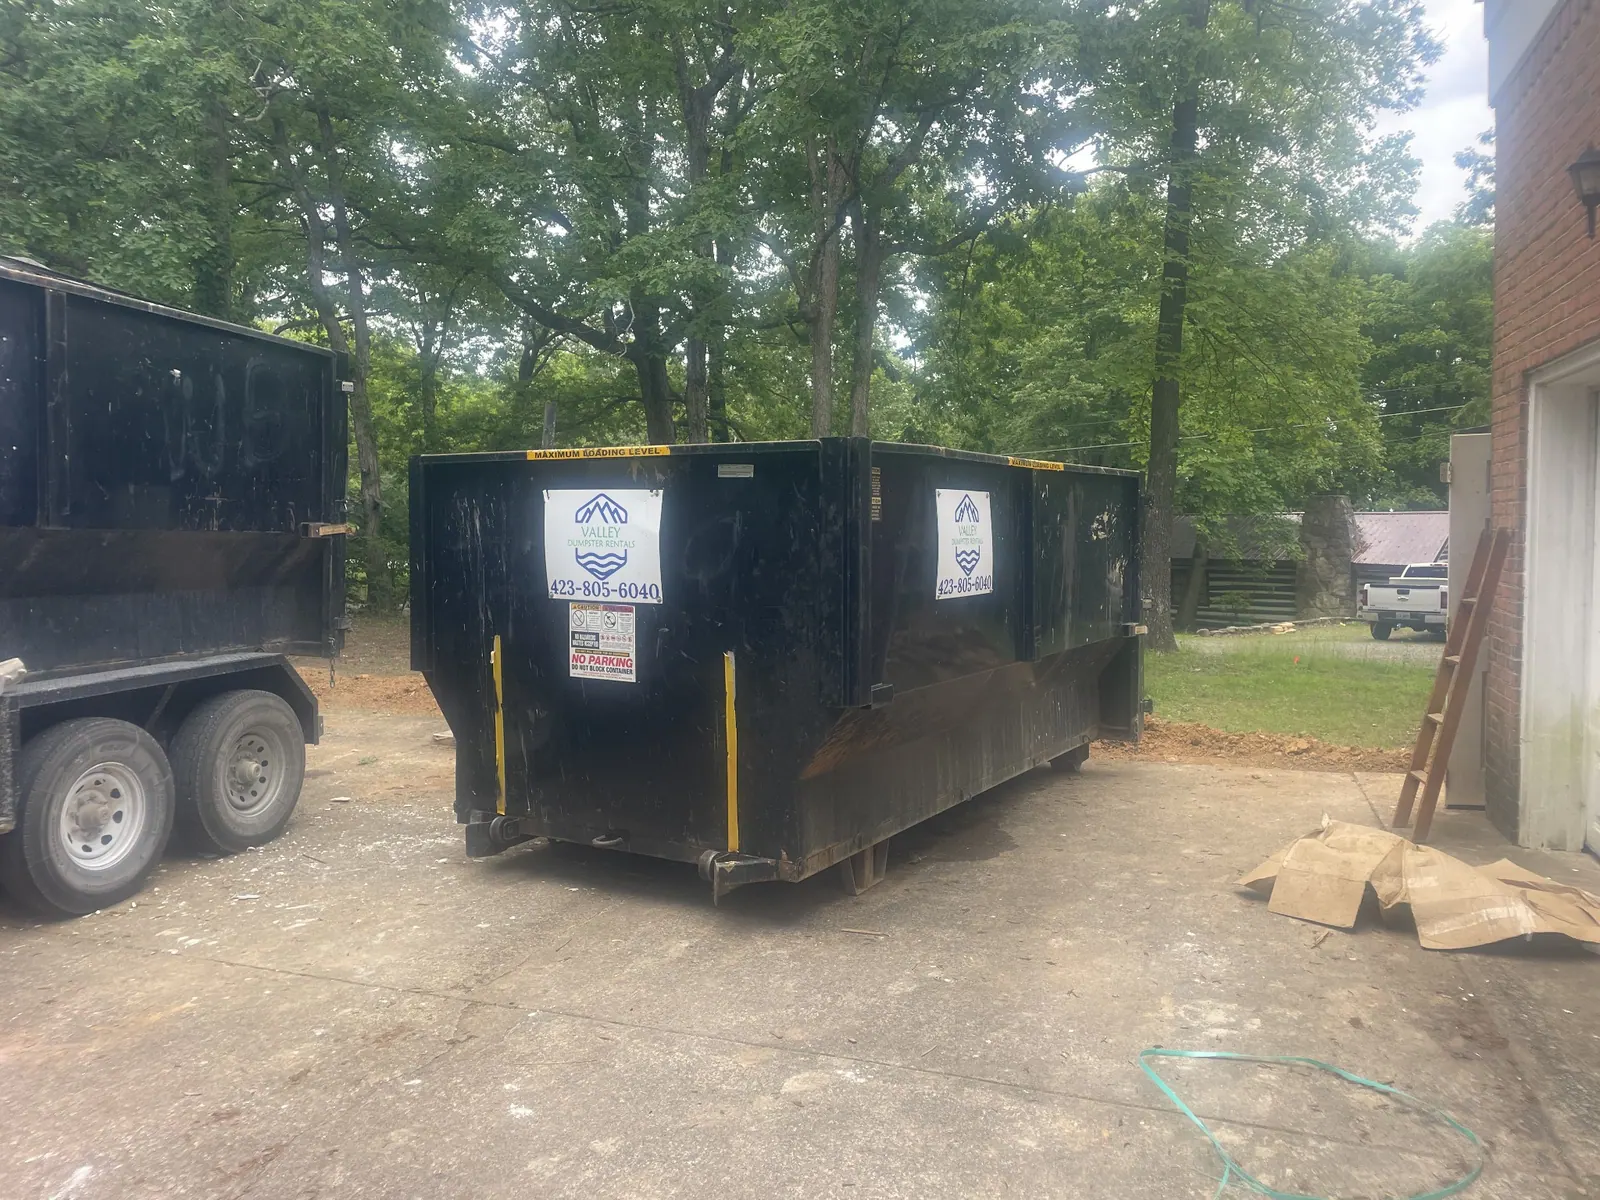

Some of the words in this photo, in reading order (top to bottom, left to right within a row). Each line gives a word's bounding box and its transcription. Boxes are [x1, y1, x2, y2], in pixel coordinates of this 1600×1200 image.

[534, 450, 580, 459] MAXIMUM
[583, 449, 626, 457] LOADING
[629, 447, 660, 456] LEVEL
[581, 526, 620, 538] VALLEY
[958, 525, 977, 536] VALLEY
[567, 539, 603, 548] DUMPSTER
[605, 540, 635, 549] RENTALS
[550, 579, 660, 599] 423-805-6040
[938, 575, 992, 595] 423-805-6040
[572, 654, 586, 664] NO
[588, 655, 633, 668] PARKING
